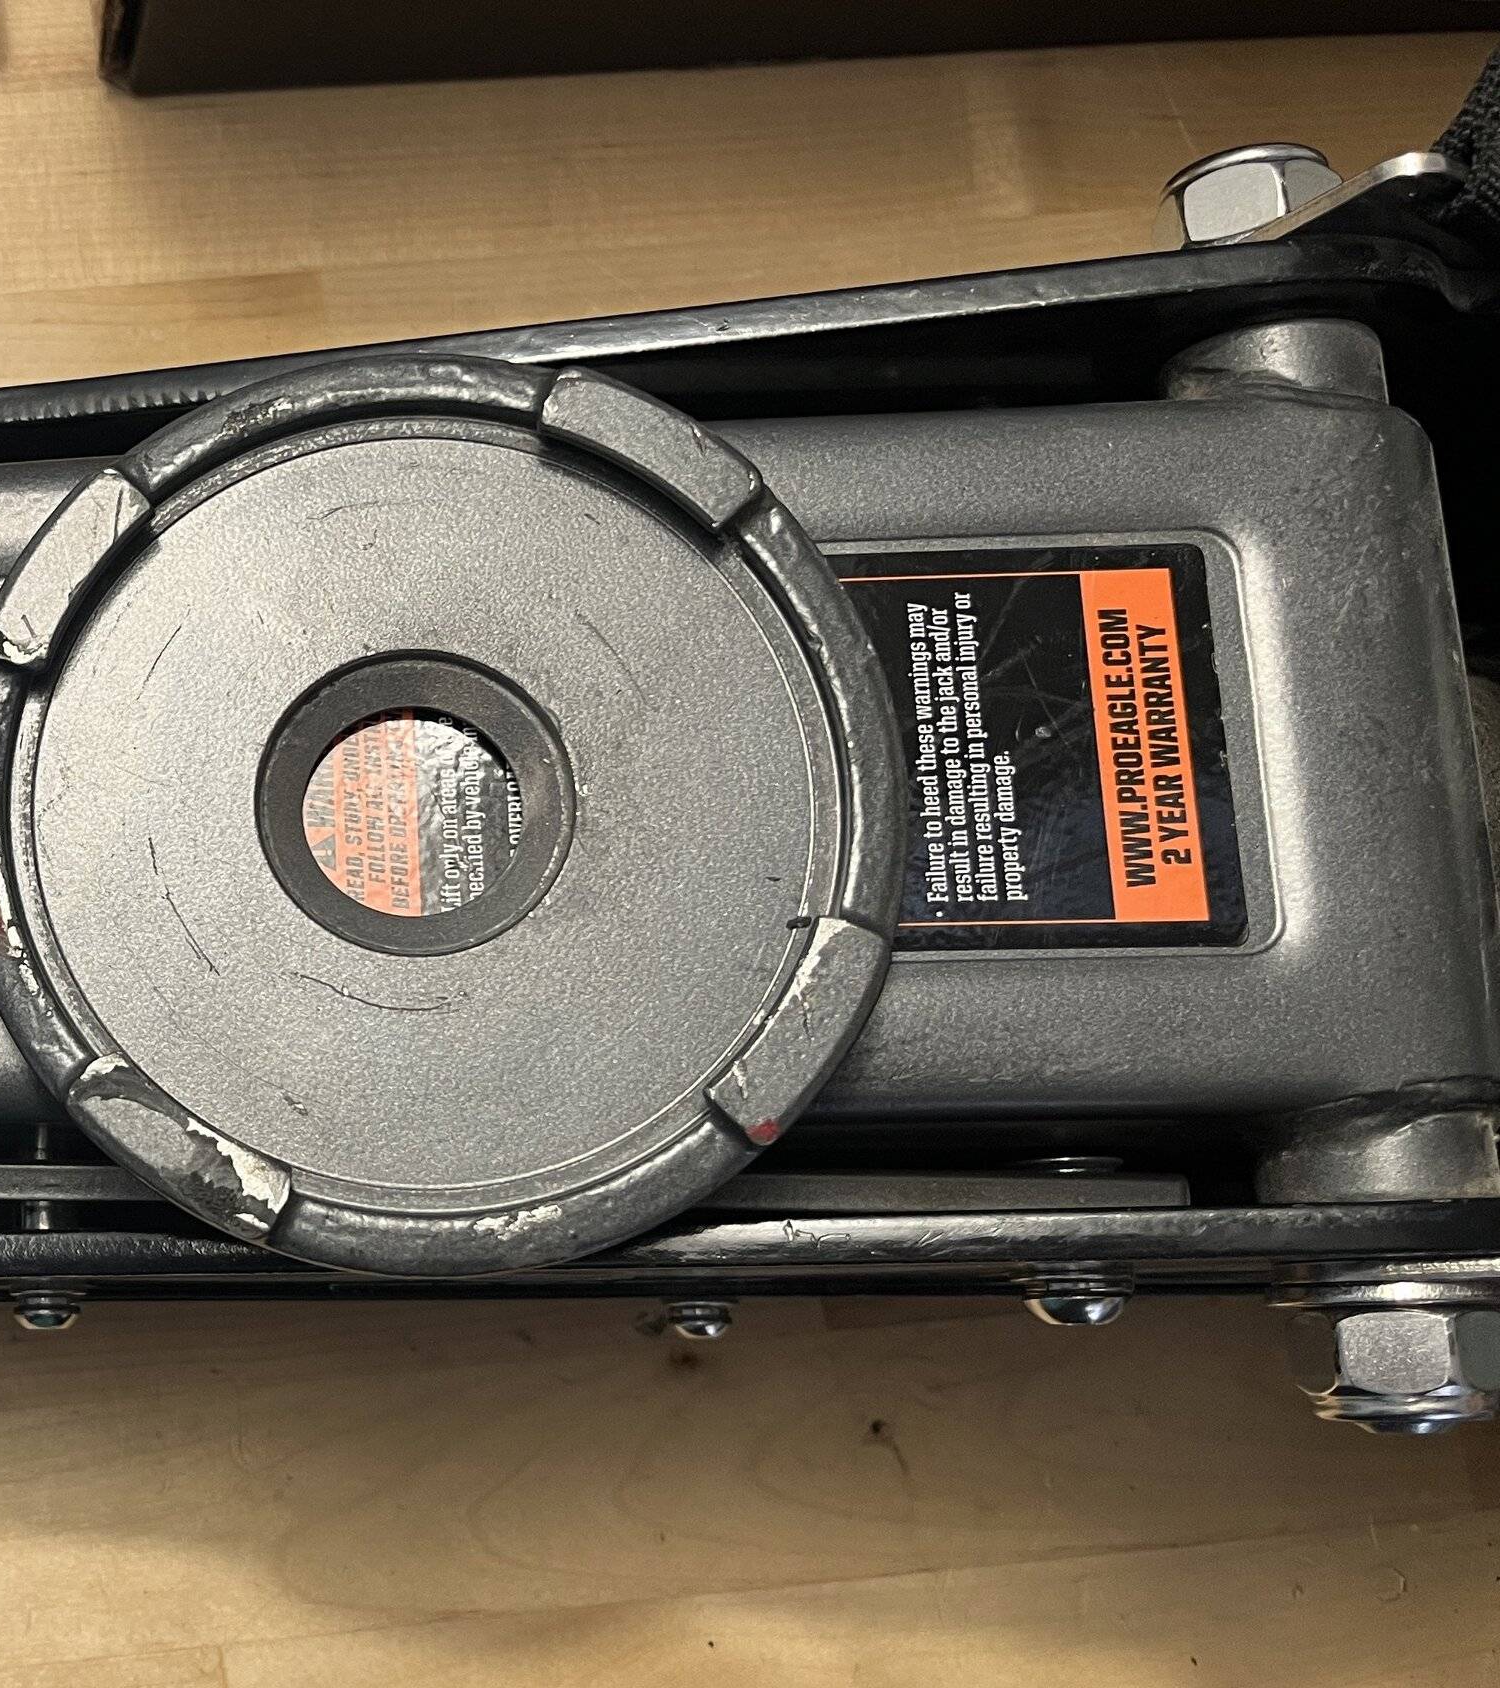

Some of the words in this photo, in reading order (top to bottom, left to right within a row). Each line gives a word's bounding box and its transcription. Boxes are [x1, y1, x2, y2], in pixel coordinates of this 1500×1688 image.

[907, 602, 928, 638] may
[954, 592, 972, 609] or
[926, 608, 952, 662] and/or
[953, 613, 980, 662] injury
[907, 641, 933, 721] warnings
[932, 665, 960, 702] jack
[955, 665, 989, 739] personal
[1135, 624, 1182, 769] WARRANTY
[936, 705, 958, 733] the
[915, 724, 937, 771] these
[940, 737, 960, 755] to
[963, 742, 985, 759] in
[1097, 608, 1156, 888] WWW.PROEAGLE.COM
[439, 768, 459, 815] areas
[459, 746, 482, 807] vehicle
[917, 775, 941, 817] heed
[945, 758, 967, 826] damage
[993, 750, 1016, 823] damage.
[461, 809, 485, 831] by
[967, 763, 991, 841] resulting
[1152, 774, 1189, 843] YEAR
[366, 816, 387, 885] FOLLOW
[442, 818, 459, 840] on
[924, 820, 943, 838] to
[947, 830, 968, 846] in
[389, 842, 411, 910] BEFORE
[439, 843, 463, 879] only
[925, 843, 949, 903] Failure
[949, 850, 974, 902] result
[975, 844, 998, 901] failure
[997, 827, 1028, 901] property
[1161, 848, 1192, 865] 2
